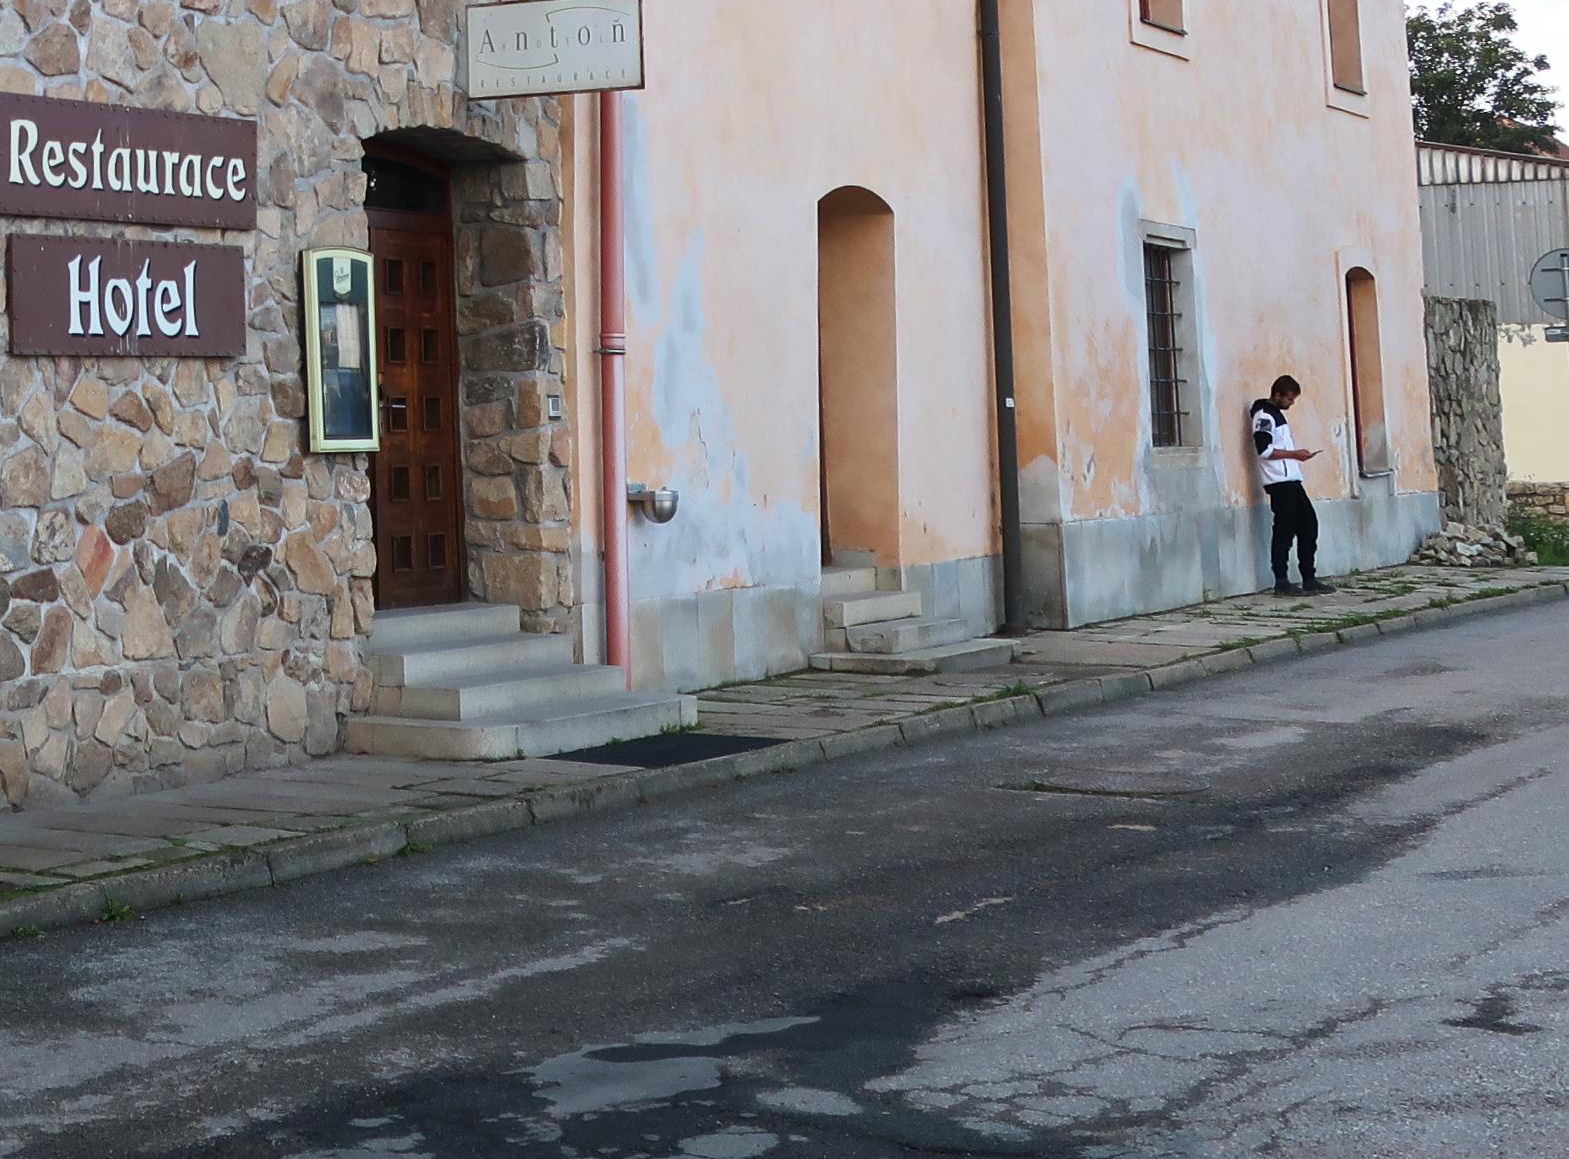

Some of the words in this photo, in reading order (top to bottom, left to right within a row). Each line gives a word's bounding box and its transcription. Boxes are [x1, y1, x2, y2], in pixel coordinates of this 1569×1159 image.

[479, 19, 626, 54] Antoň
[480, 68, 628, 88] RESTAURACE
[8, 119, 246, 202] Restaurace
[67, 254, 199, 337] Hotel
